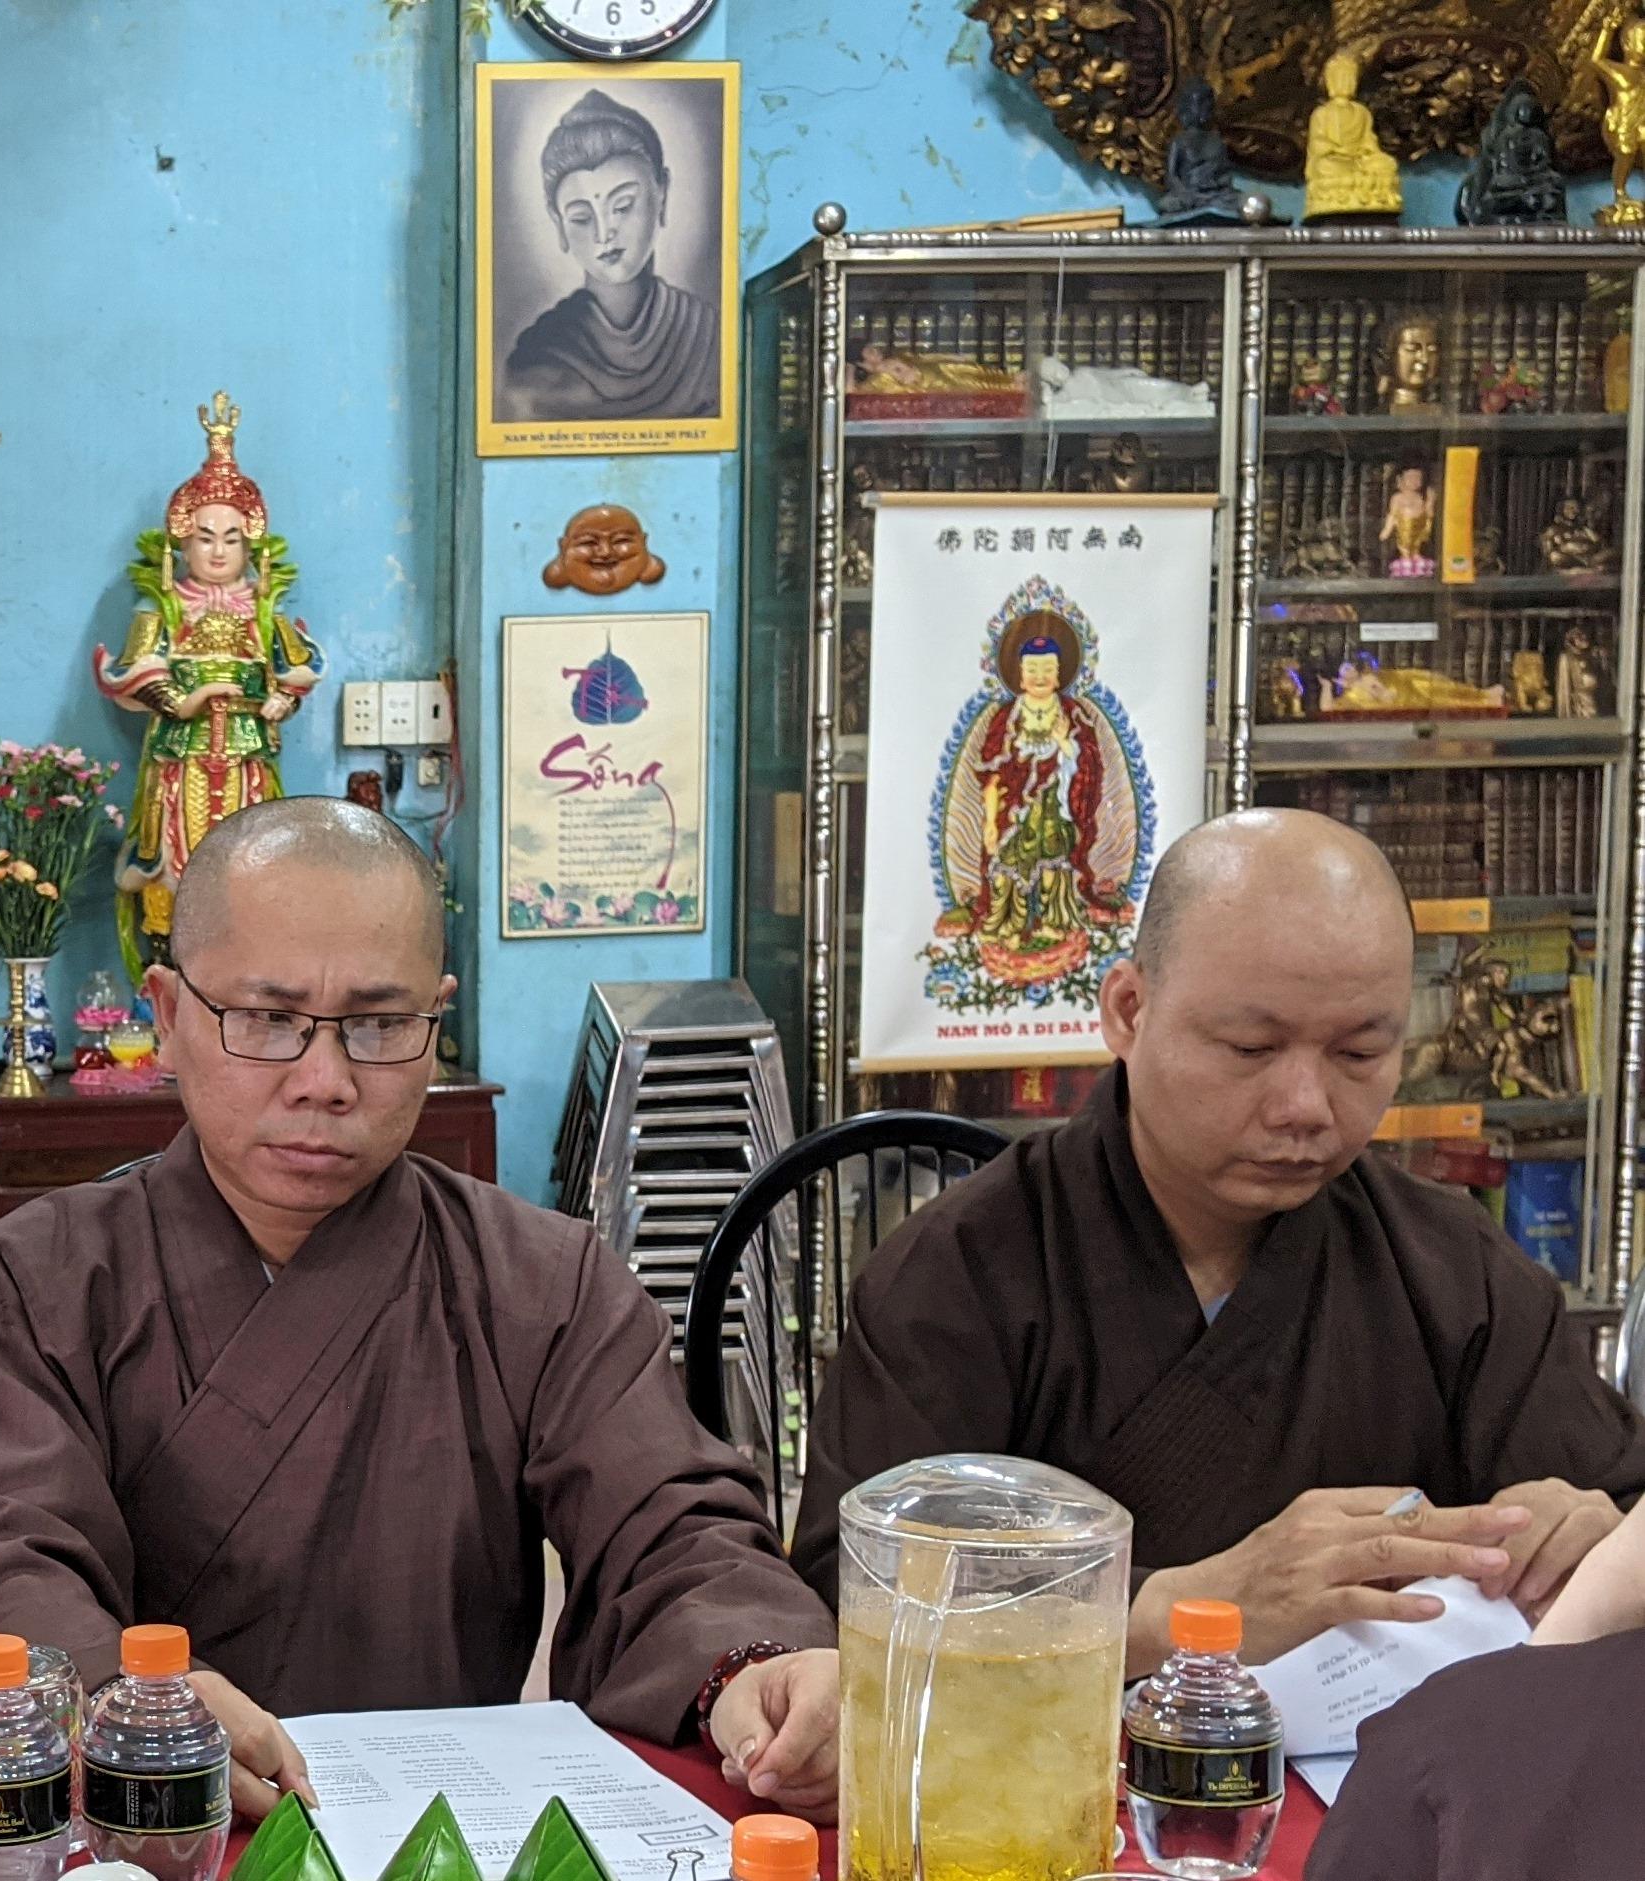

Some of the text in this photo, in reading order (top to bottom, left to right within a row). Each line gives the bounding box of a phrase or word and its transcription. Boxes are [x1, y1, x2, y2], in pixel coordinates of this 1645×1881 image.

[606, 1, 621, 25] 6
[937, 1025, 978, 1038] NAM
[1017, 1023, 1029, 1036] A
[1034, 1022, 1054, 1035] DI
